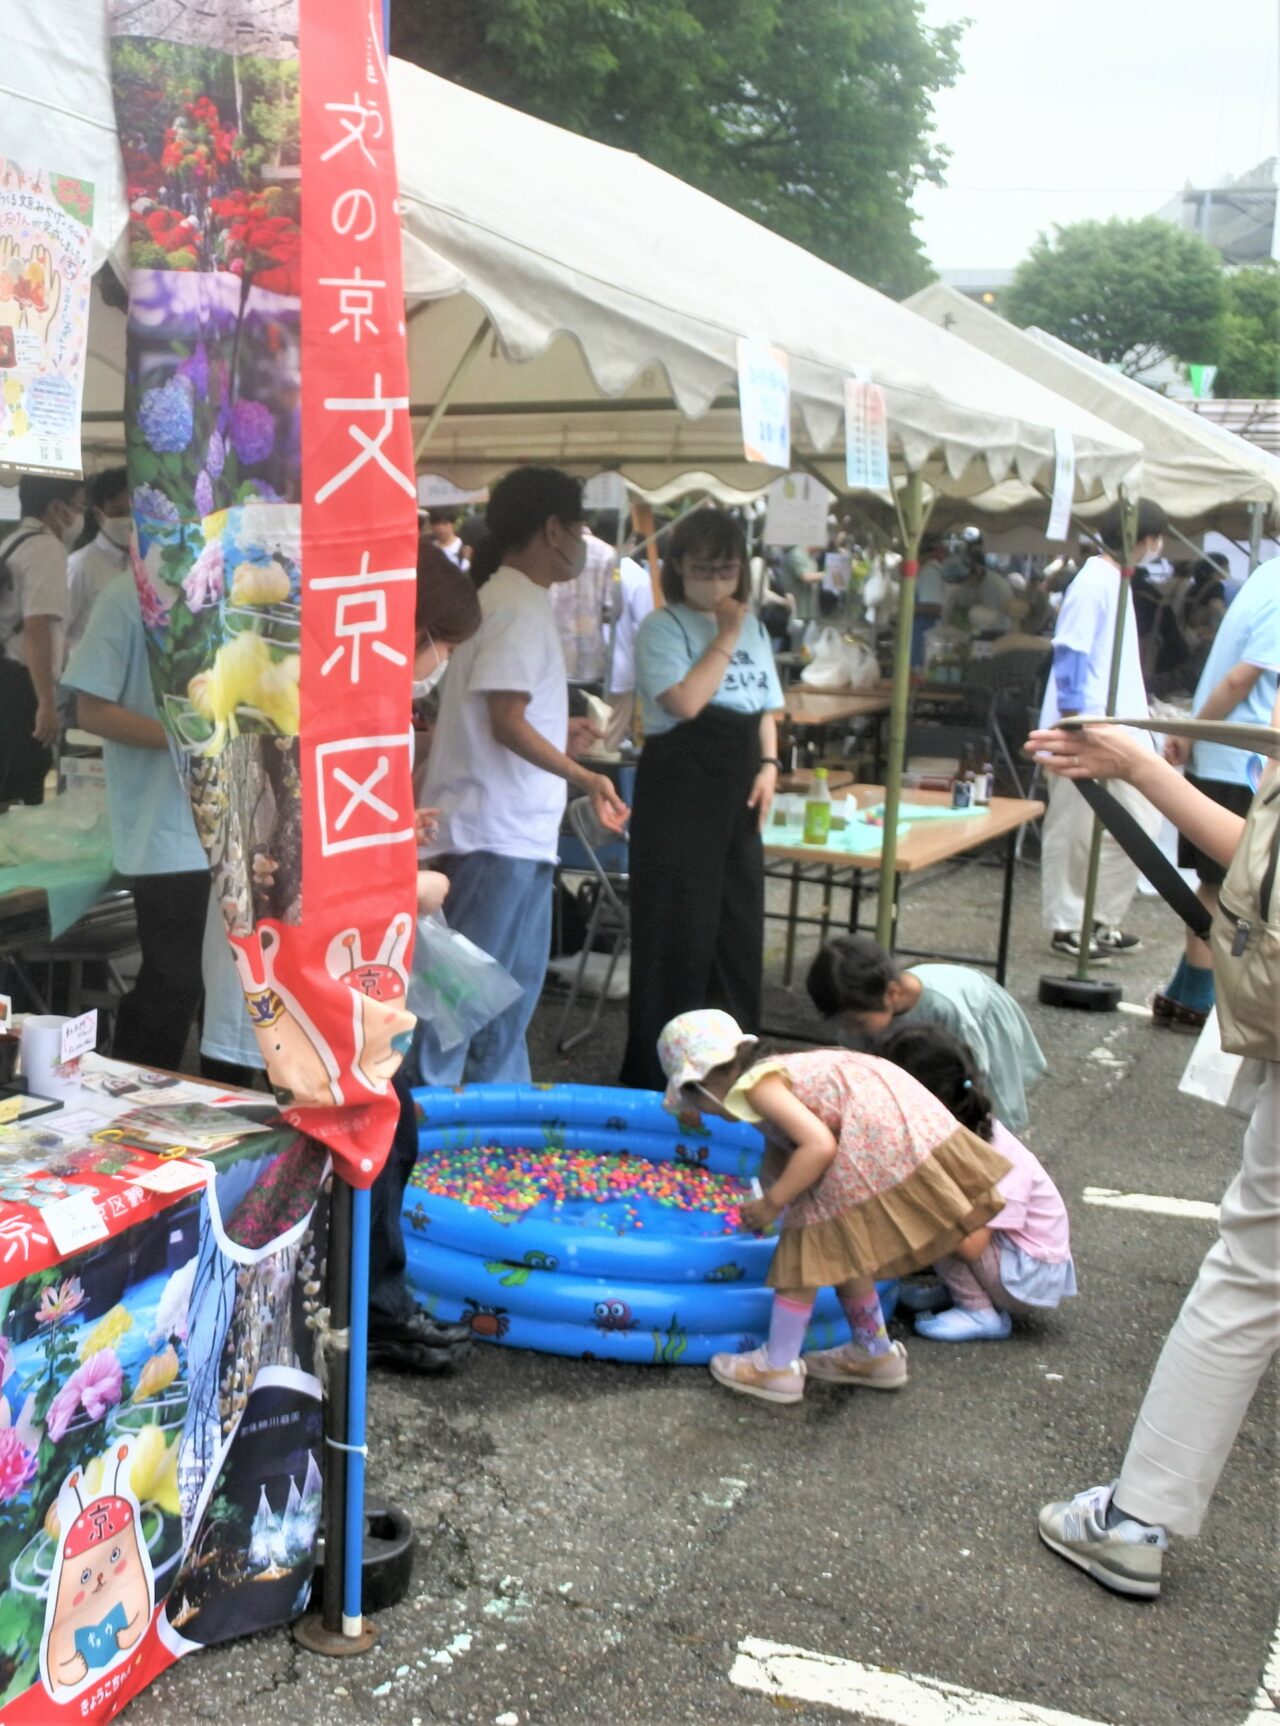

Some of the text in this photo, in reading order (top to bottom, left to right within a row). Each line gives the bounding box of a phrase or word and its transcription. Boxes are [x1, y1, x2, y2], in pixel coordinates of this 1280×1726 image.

[318, 91, 387, 343] 文の京
[310, 372, 418, 857] 文京区
[87, 1502, 115, 1542] 京
